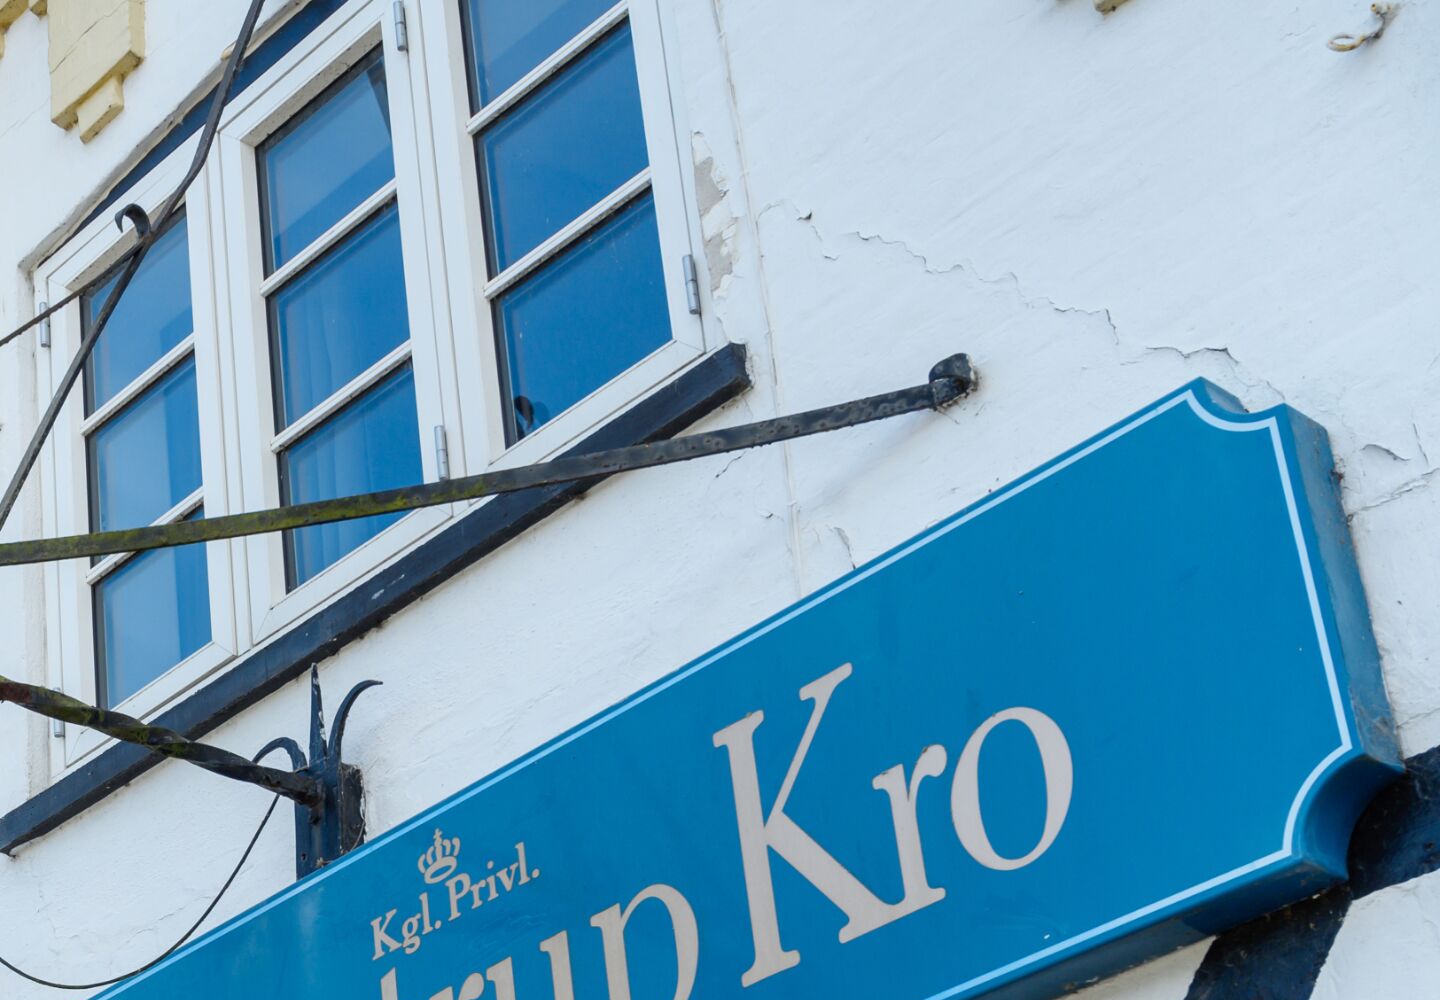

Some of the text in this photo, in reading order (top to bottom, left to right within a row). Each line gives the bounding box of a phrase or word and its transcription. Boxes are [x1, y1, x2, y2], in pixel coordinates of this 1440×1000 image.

[370, 842, 540, 961] Kgl. Privl.
[713, 663, 1074, 988] Kro
